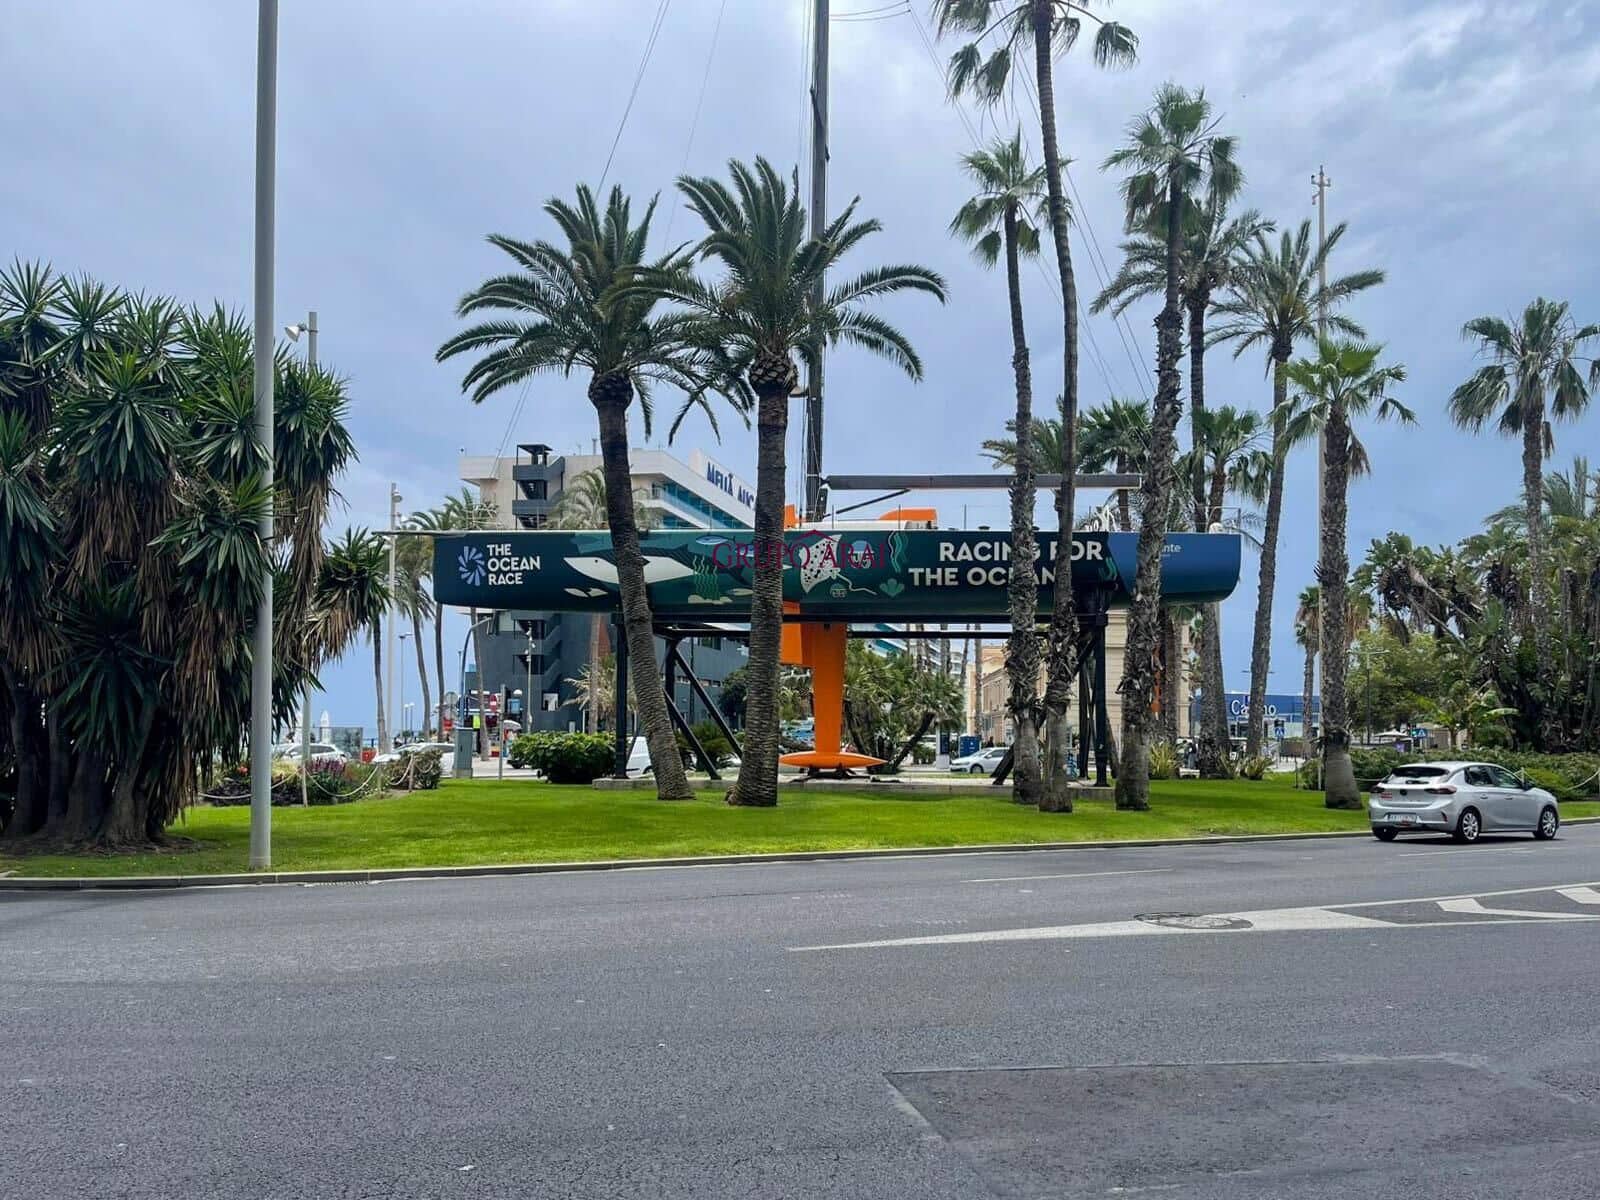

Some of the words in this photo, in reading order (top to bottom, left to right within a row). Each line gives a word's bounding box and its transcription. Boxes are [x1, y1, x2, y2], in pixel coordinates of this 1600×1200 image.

[487, 544, 512, 556] THE
[487, 556, 541, 571] OCEAN
[488, 573, 523, 585] RACE
[908, 567, 959, 586] THE
[1231, 700, 1277, 717] Cano
